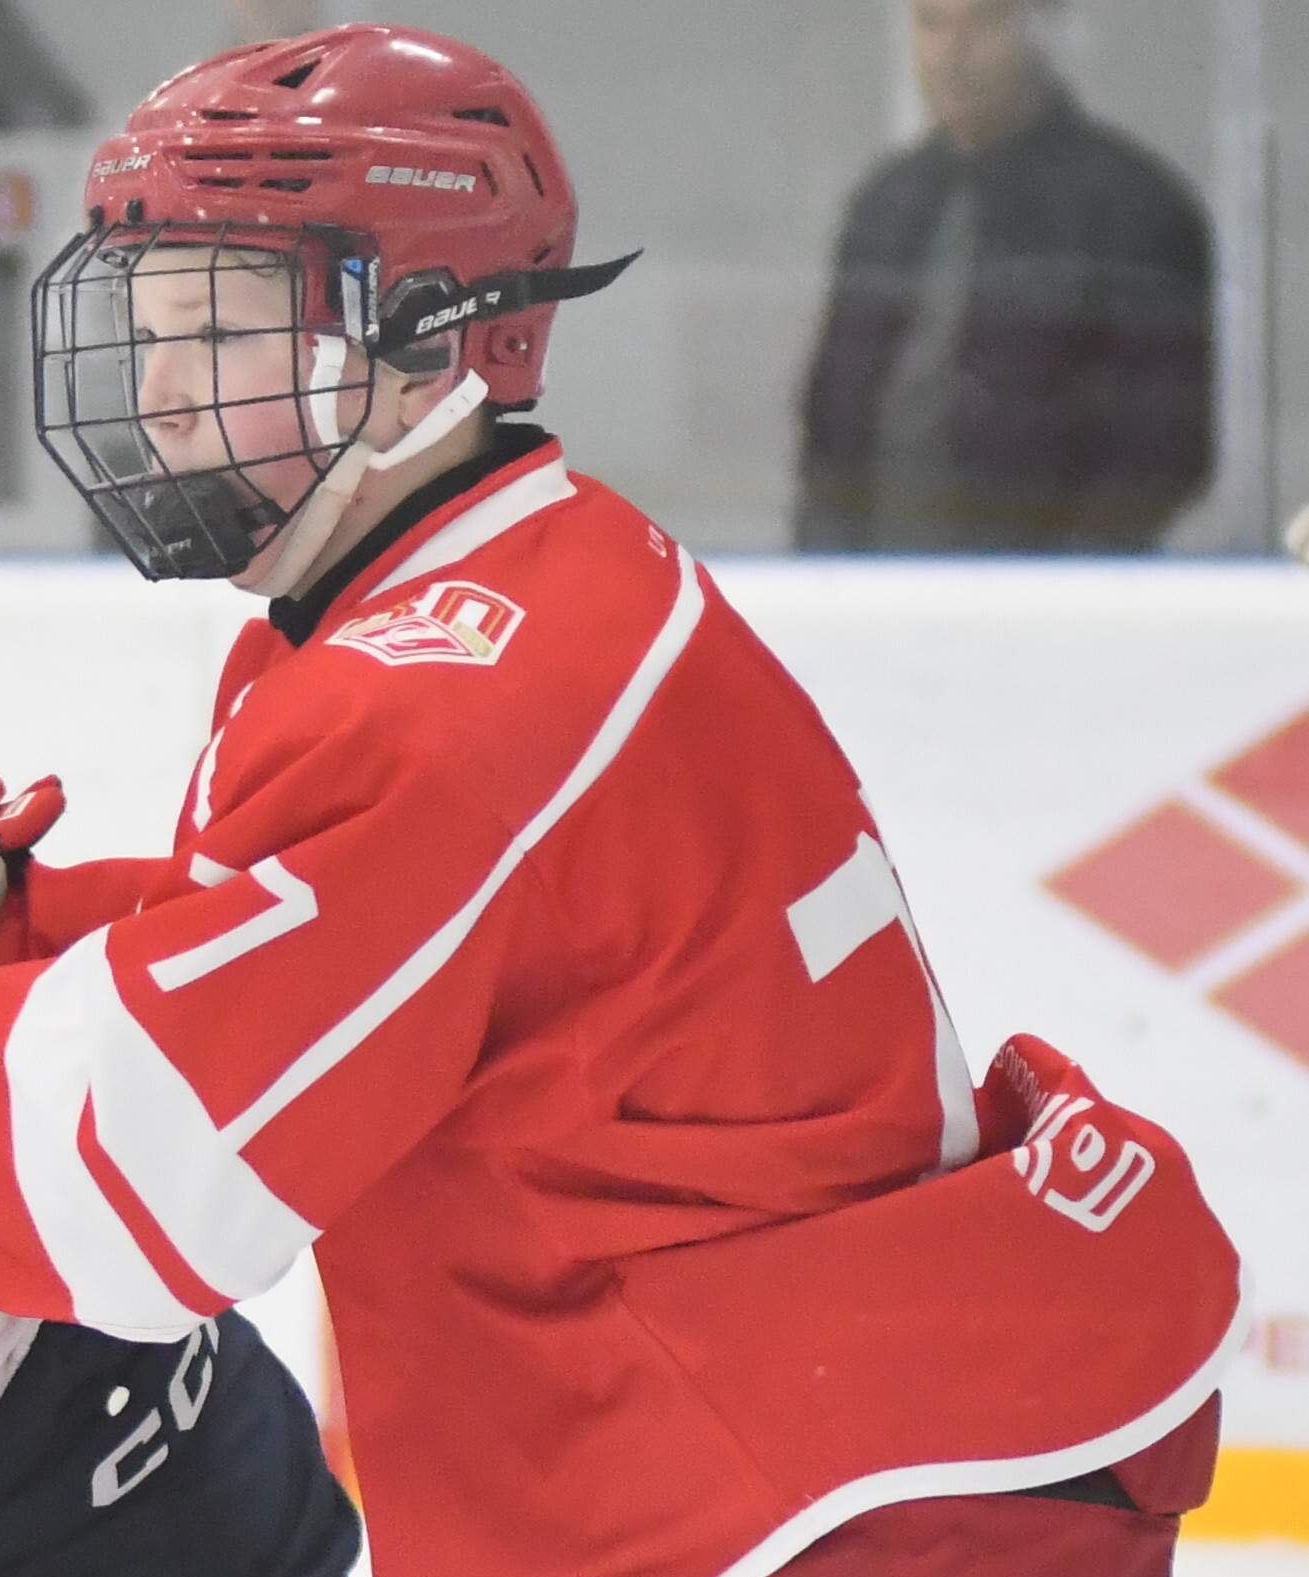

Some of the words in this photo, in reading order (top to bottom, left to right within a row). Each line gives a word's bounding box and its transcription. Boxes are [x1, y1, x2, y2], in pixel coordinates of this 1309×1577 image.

[365, 165, 477, 193] BAUER
[415, 291, 502, 335] BAUER
[147, 852, 319, 992] 7
[92, 1318, 220, 1508] CC
